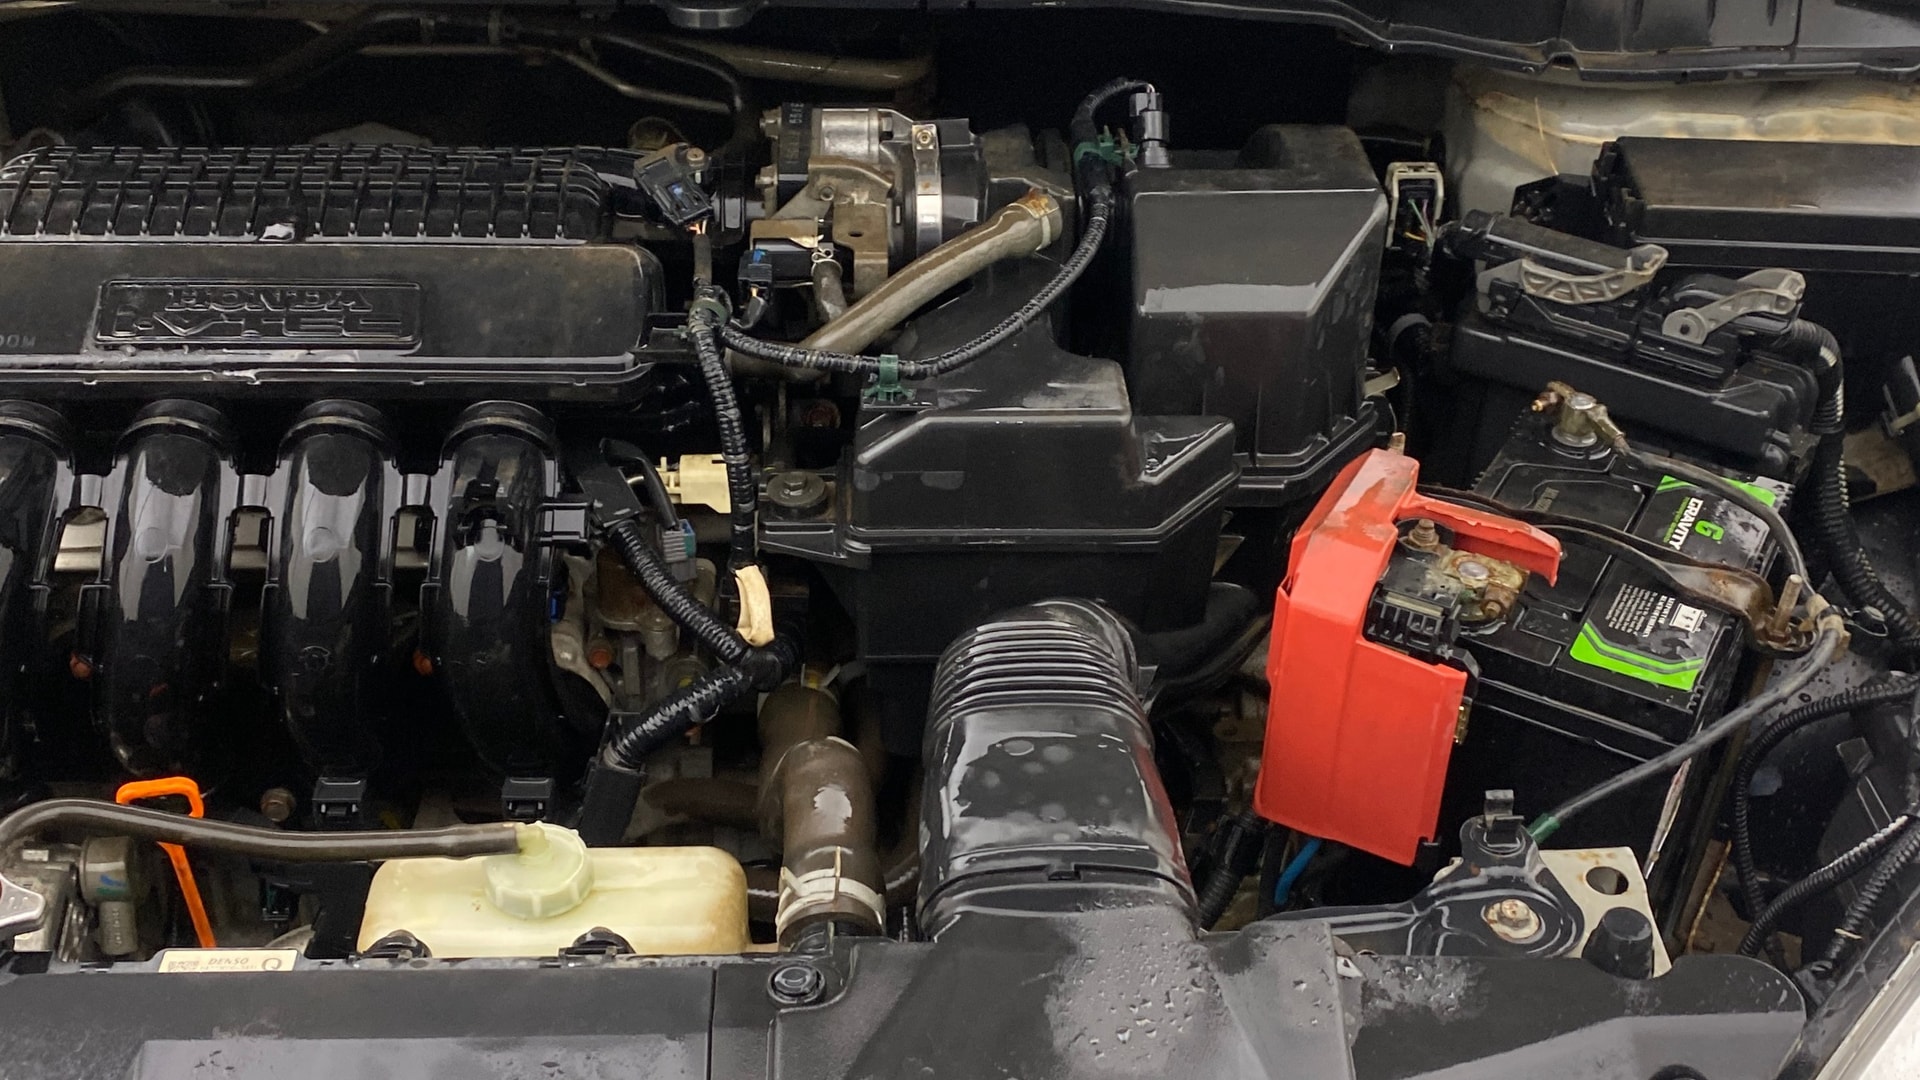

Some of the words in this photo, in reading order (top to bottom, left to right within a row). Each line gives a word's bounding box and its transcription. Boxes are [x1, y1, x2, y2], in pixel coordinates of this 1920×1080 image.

[164, 289, 373, 312] HONDA
[1669, 497, 1704, 550] GRAVITY
[208, 957, 249, 966] DENSO
